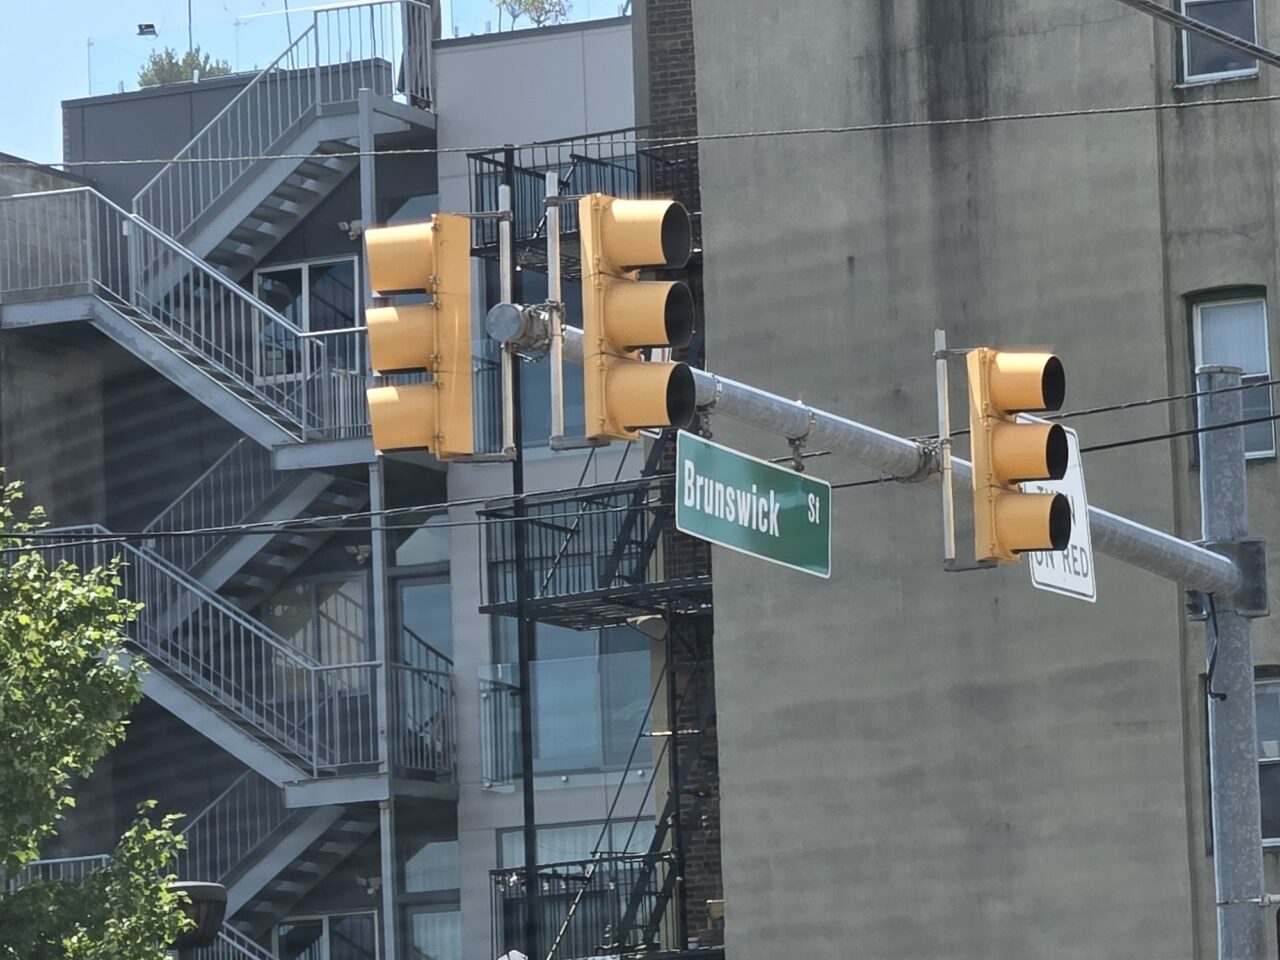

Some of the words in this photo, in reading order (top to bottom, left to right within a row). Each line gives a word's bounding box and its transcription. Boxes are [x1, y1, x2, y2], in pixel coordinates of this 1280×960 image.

[684, 459, 780, 537] Brunswick
[807, 492, 820, 525] St
[1062, 545, 1090, 578] RED
